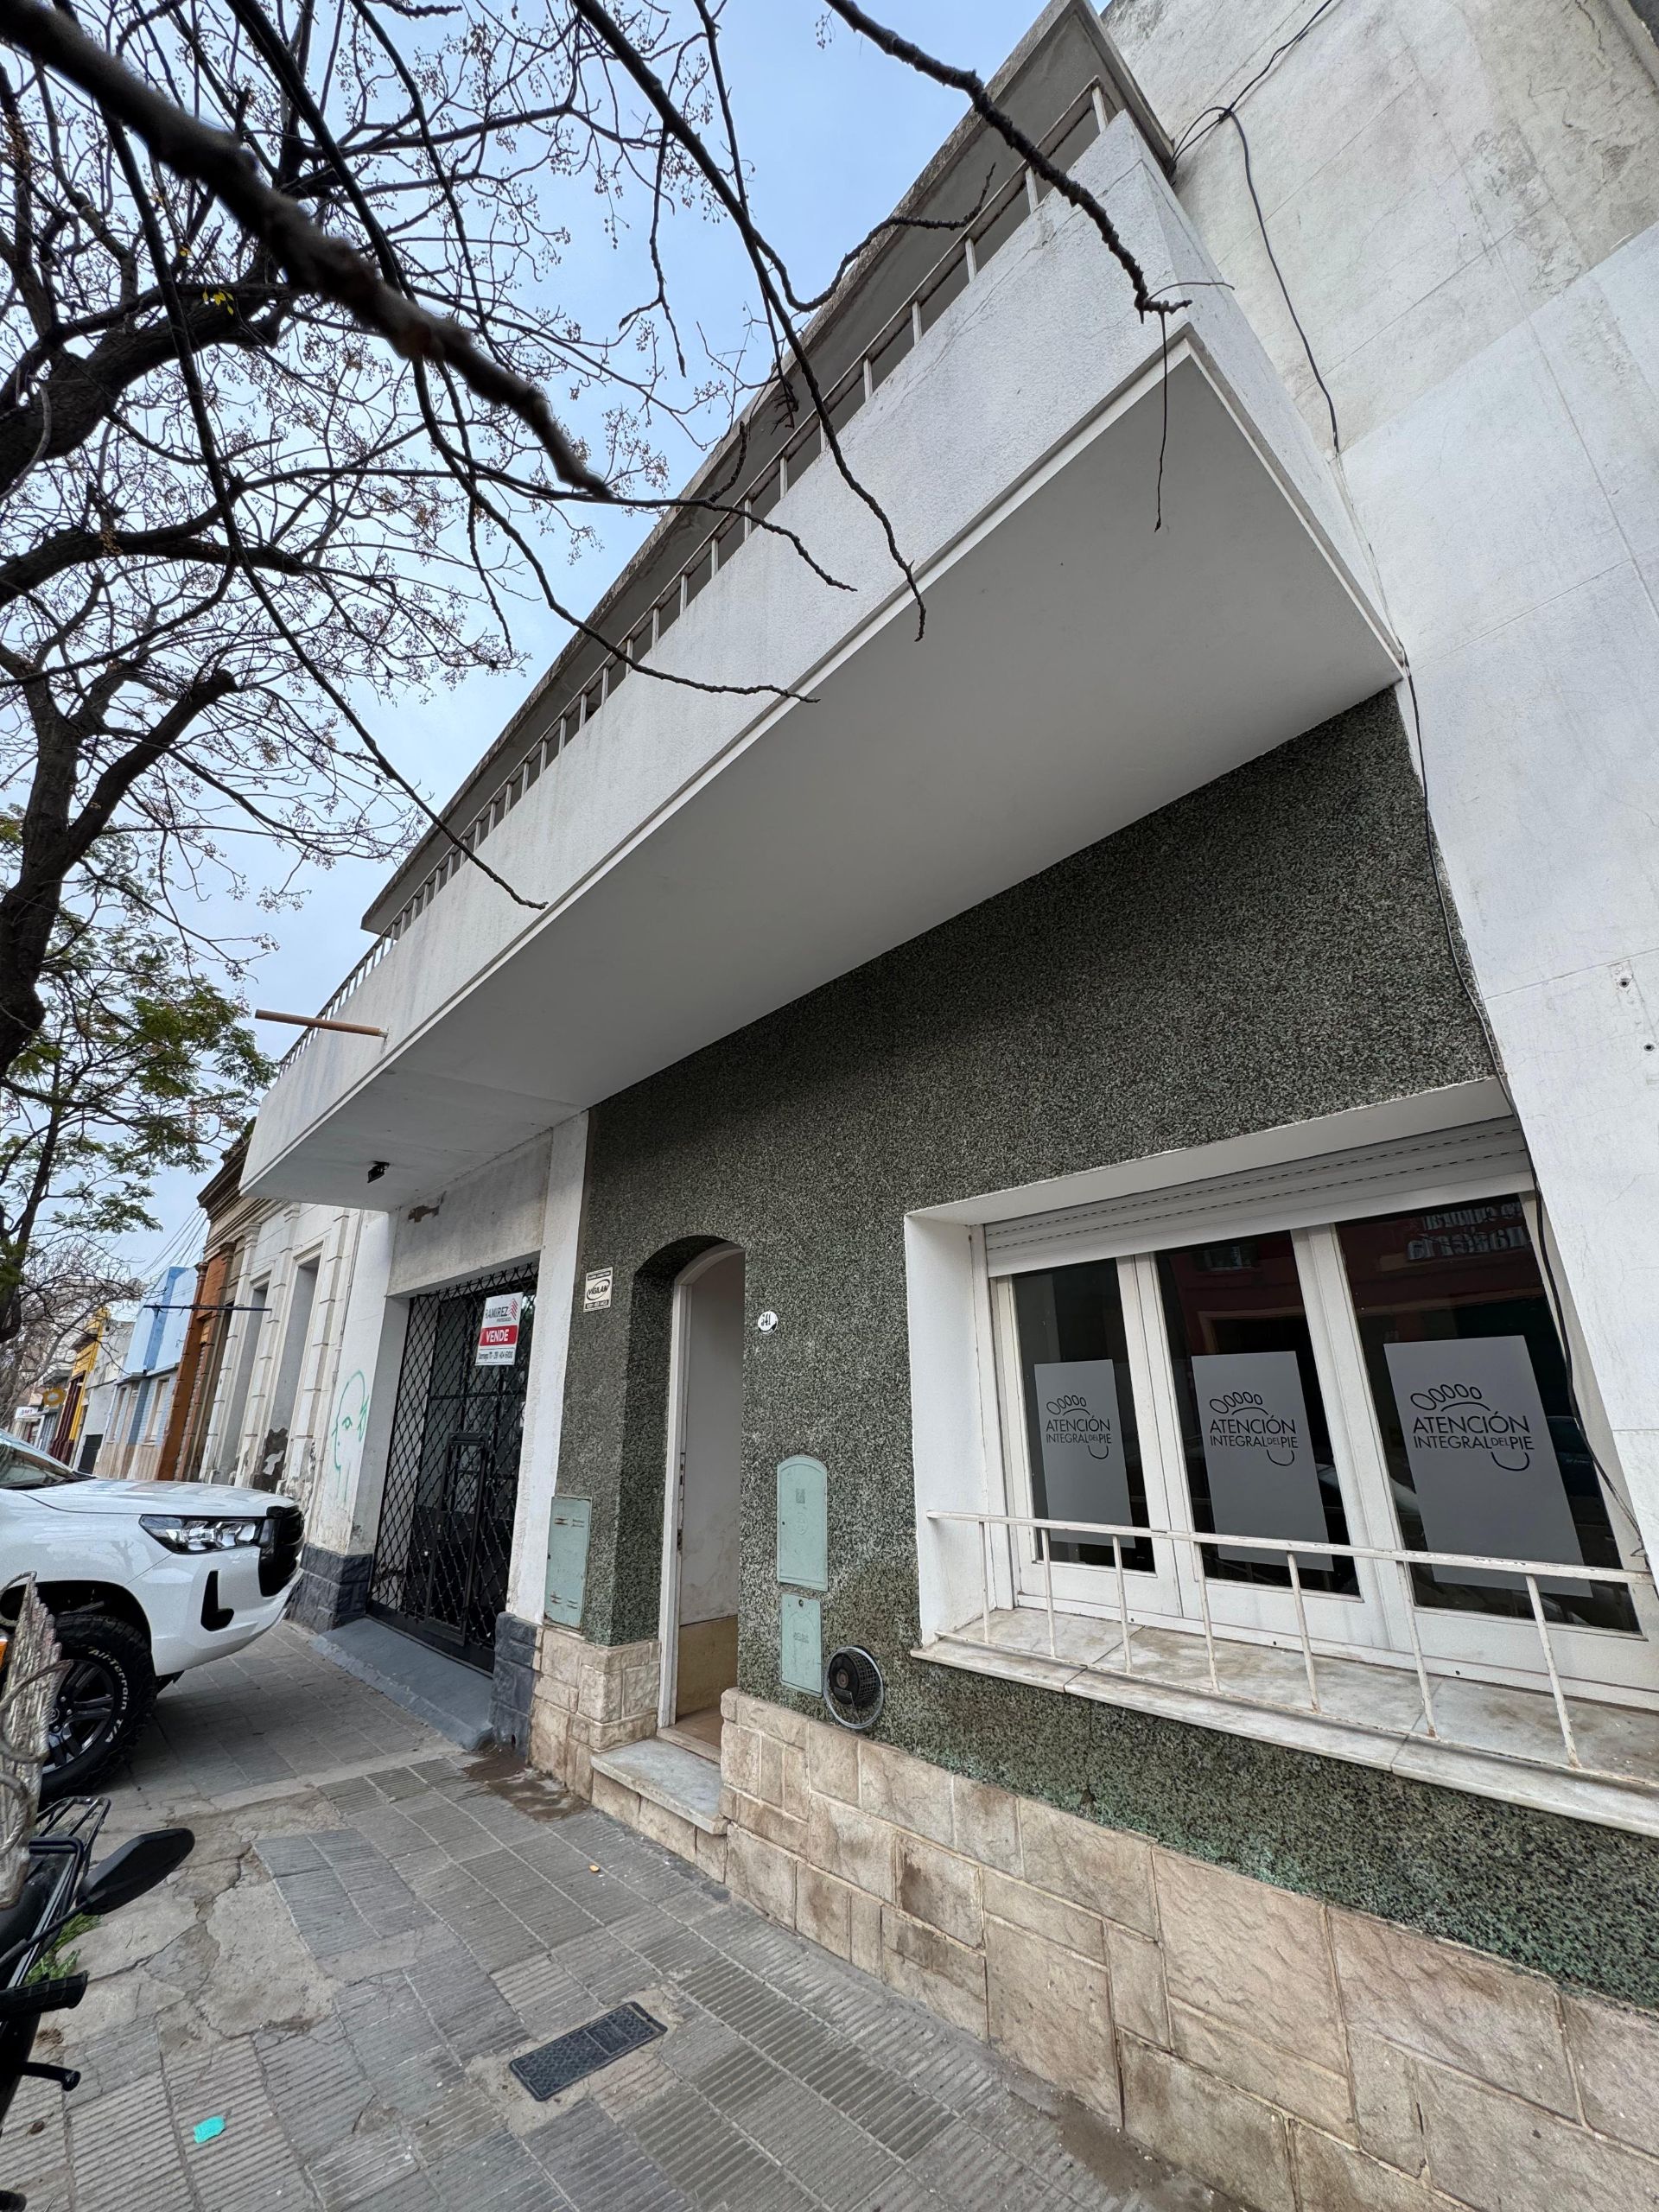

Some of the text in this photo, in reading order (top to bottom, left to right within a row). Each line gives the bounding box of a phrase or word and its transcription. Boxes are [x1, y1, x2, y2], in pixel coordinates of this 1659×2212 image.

[486, 1329, 510, 1343] VENDE
[1046, 1414, 1111, 1432] ATENCIÓN
[1210, 1414, 1296, 1434] ATENCIÓN
[1413, 1411, 1530, 1433] ATENCIÓN
[1046, 1433, 1089, 1444] INTEGRAL
[1099, 1433, 1112, 1444] PIE
[1210, 1434, 1268, 1447] INTEGRAL
[1281, 1436, 1299, 1448] PIE
[1414, 1435, 1535, 1451] INTEGRAL DEL PIE
